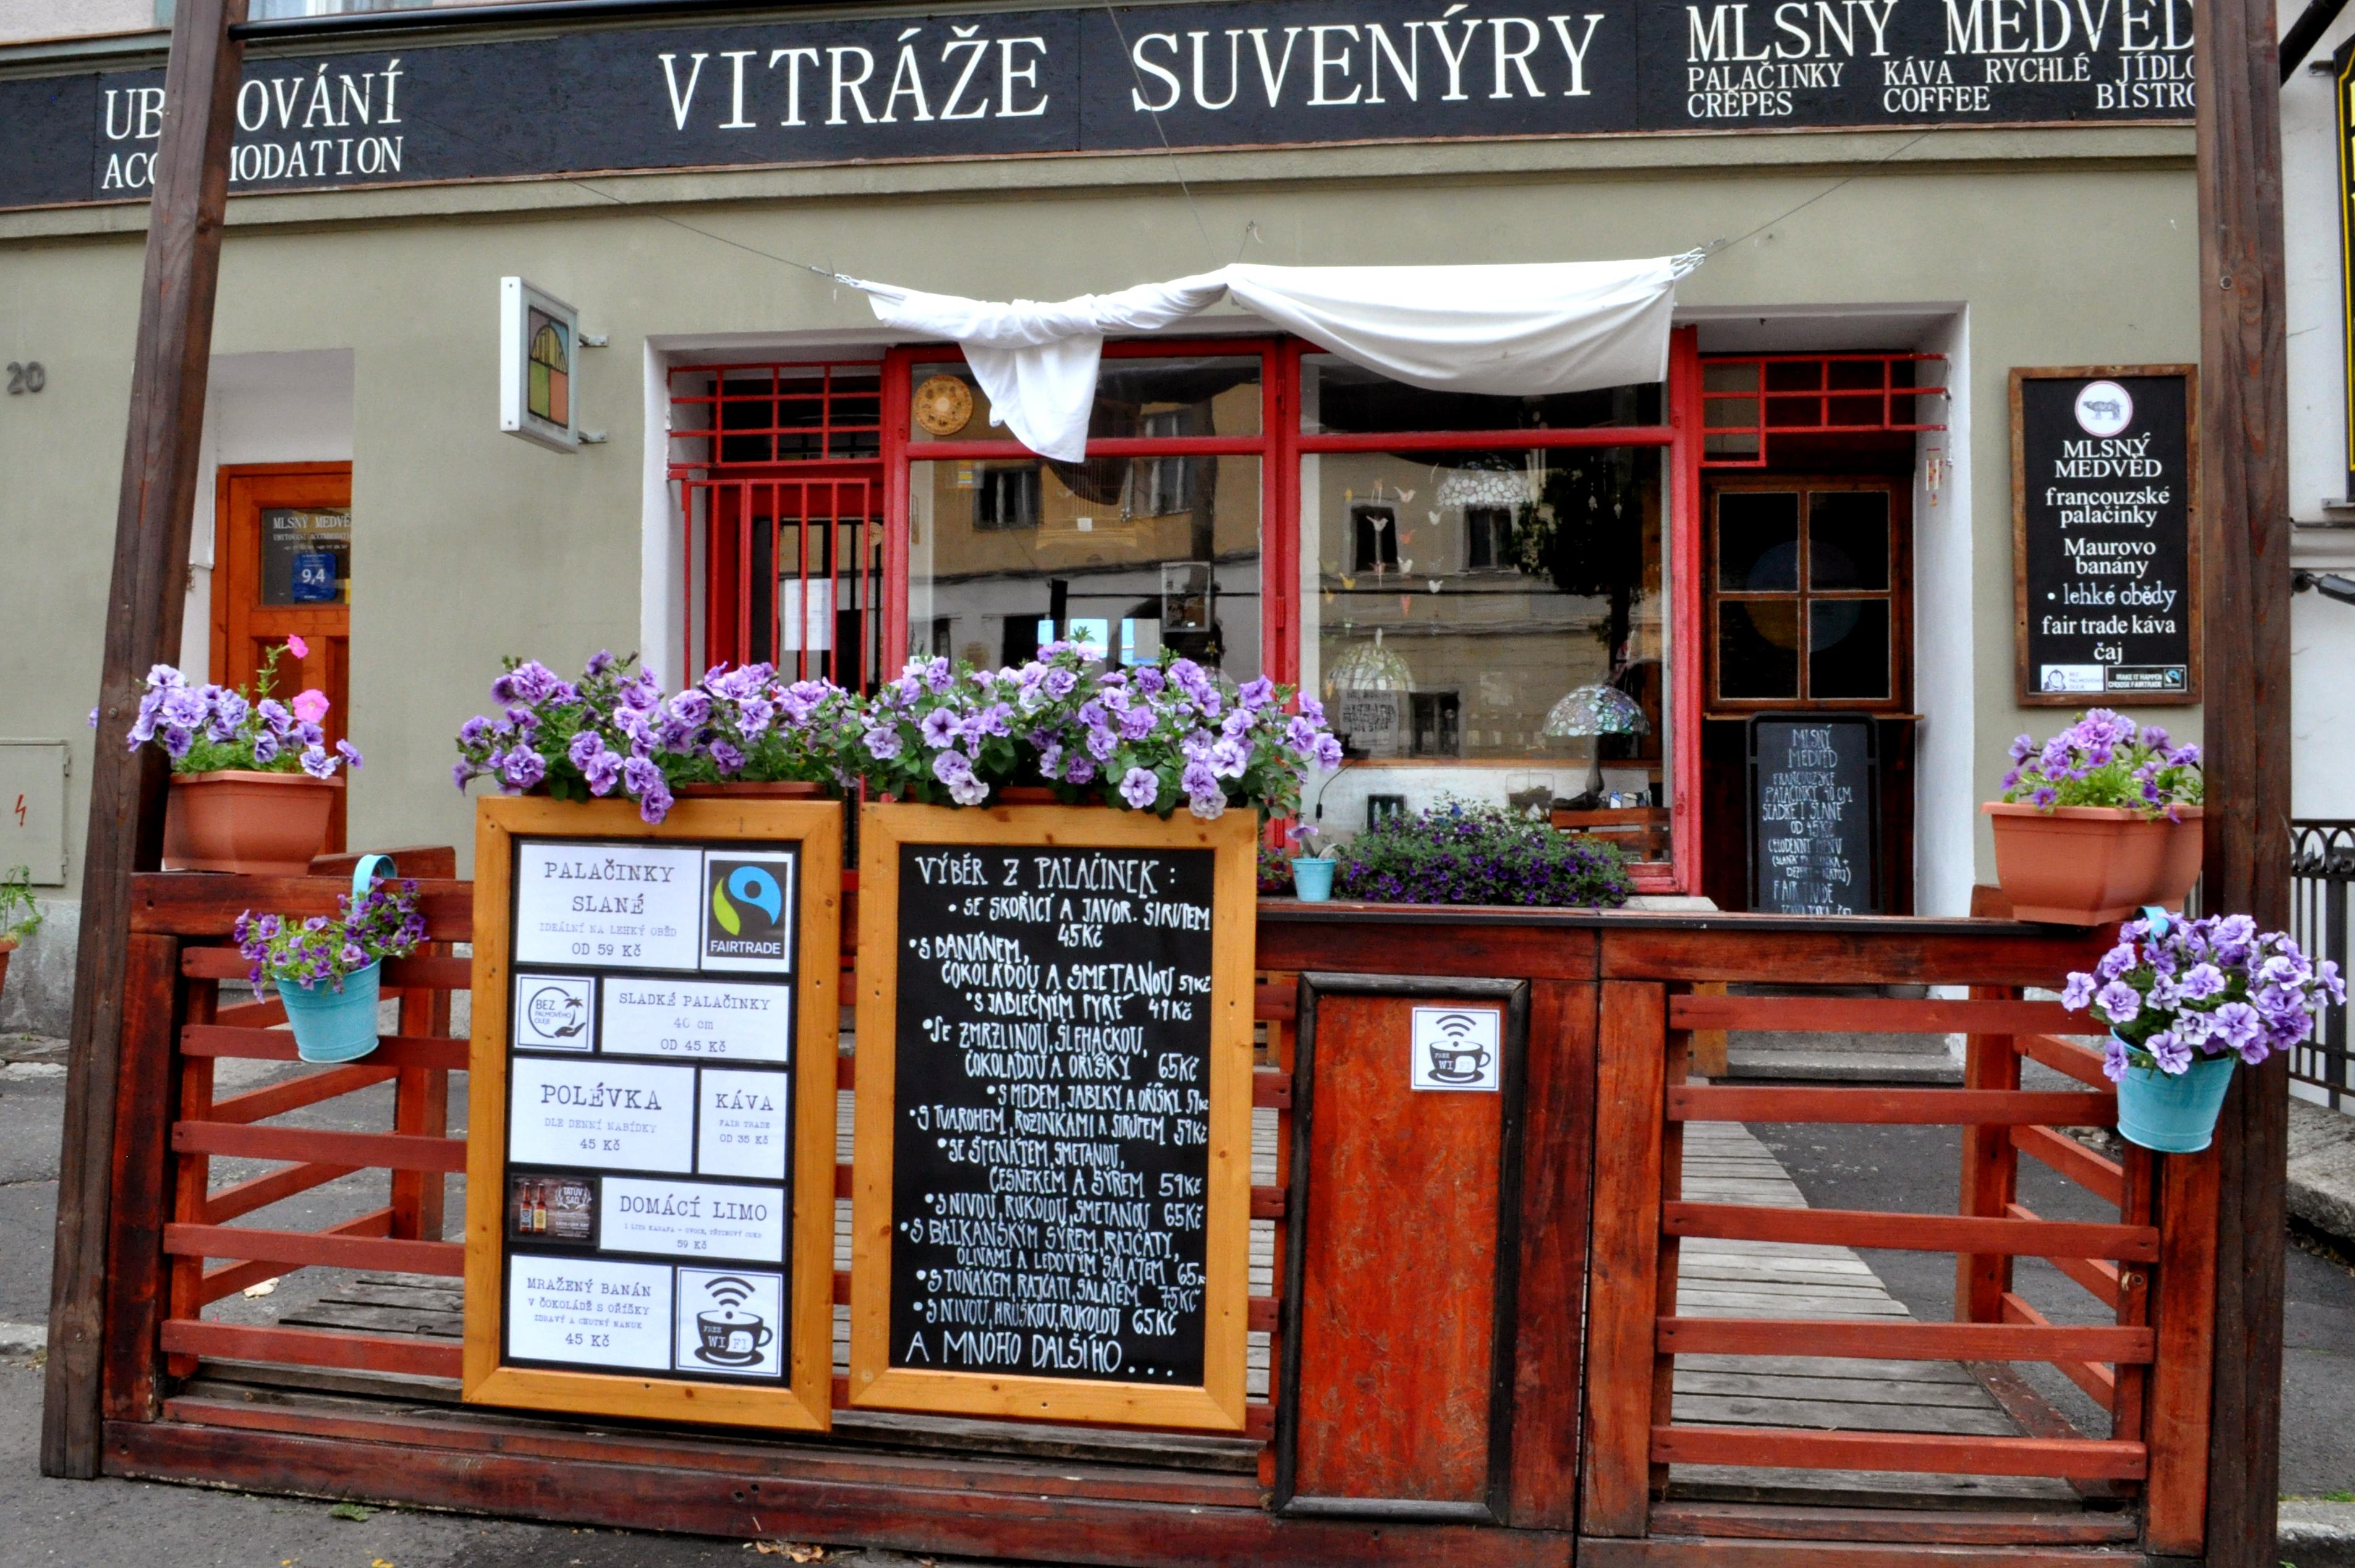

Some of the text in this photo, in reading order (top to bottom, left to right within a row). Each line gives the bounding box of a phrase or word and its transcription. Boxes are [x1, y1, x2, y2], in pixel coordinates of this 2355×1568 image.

[1132, 4, 1605, 114] SUVENÝRY
[658, 25, 1049, 131] VITRÁŽE
[1687, 61, 1844, 92] PALAČINKY
[1883, 56, 1954, 86] KÁVA
[1985, 52, 2092, 83] RYCHLÉ
[105, 59, 404, 140] UBOVÁNÍ
[1687, 90, 1793, 118] CRÊPES
[1883, 85, 1990, 112] COFFEE
[101, 136, 404, 189] ACODATION
[7, 361, 45, 395] 20
[2063, 433, 2151, 459] MLSNÝ
[2055, 452, 2162, 478] MEDVĚD
[2045, 486, 2170, 506] francouzské
[2060, 506, 2157, 528] palačinky
[2064, 538, 2156, 556] Maurovo
[302, 569, 325, 585] 9,4
[2076, 557, 2149, 579] banány
[2063, 580, 2177, 612] lehké obědy
[2042, 616, 2176, 635] fair trade káva
[2094, 642, 2123, 664] čaj
[544, 858, 675, 883] PALAČINKY
[914, 852, 1160, 899] VÝBĚR PALAČINEK
[572, 893, 644, 915] SLANÉ
[963, 897, 984, 917] SE
[990, 891, 1055, 923] SKOŘICÍ
[1144, 902, 1211, 931] SIRUPEM
[590, 925, 605, 934] NA
[610, 925, 646, 936] LEHKÝ
[572, 943, 642, 957] OD 59 Kč
[710, 940, 781, 955] FAIRTRADE
[941, 961, 1040, 990] ČOKOLÁDOU
[1067, 960, 1176, 996] SMETANOU
[536, 999, 555, 1011] BEZ
[619, 992, 771, 1011] SLADKÉ PALAČINKY
[988, 989, 1075, 1022] JABLEČNÝM
[1084, 993, 1135, 1023] PYRÉ
[673, 1017, 714, 1030] 40 cm
[930, 1015, 953, 1043] SE
[660, 1039, 726, 1053] OD 45 Kč
[965, 1049, 1047, 1080] ČOKOLÁDOU
[1069, 1051, 1132, 1080] OŘÍŠKY
[1438, 1060, 1453, 1070] WI
[541, 1082, 662, 1111] POLÉVKA
[715, 1090, 774, 1111] KÁVA
[1067, 1085, 1122, 1111] JABLKY
[1138, 1082, 1182, 1116] OŘÍŠKY
[719, 1119, 770, 1129] FAIR TRADE
[1014, 1109, 1095, 1139] ROZINKAMI
[1111, 1112, 1166, 1145] SIRUPEM
[580, 1138, 621, 1151] 45 Kč
[719, 1134, 769, 1145] OD 35 Kč
[948, 1142, 965, 1162] SE
[989, 1164, 1067, 1194] ČESNEKEM
[1091, 1166, 1145, 1198] SÝREM
[620, 1194, 768, 1221] DOMÁCÍ LIMO
[1074, 1199, 1150, 1229] SMETANOU
[677, 1240, 707, 1249] 59 Kč
[929, 1218, 1038, 1249] BALKÁNSKÝM
[956, 1247, 1165, 1286] OLIVAMI LEDOVÝM SALÁTEM
[527, 1277, 651, 1297] MRAŽENÝ BANÁN
[1076, 1278, 1141, 1307] SALÁTEM
[540, 1297, 650, 1315] ČOKOLÁDĚ OŘÍŠKY
[703, 1325, 722, 1333] FREE
[1059, 1302, 1121, 1336] RUKOLOU
[566, 1333, 609, 1347] 45 Kč
[708, 1336, 748, 1350] WI FI
[906, 1331, 929, 1362] A
[943, 1331, 1021, 1365] MNOHO
